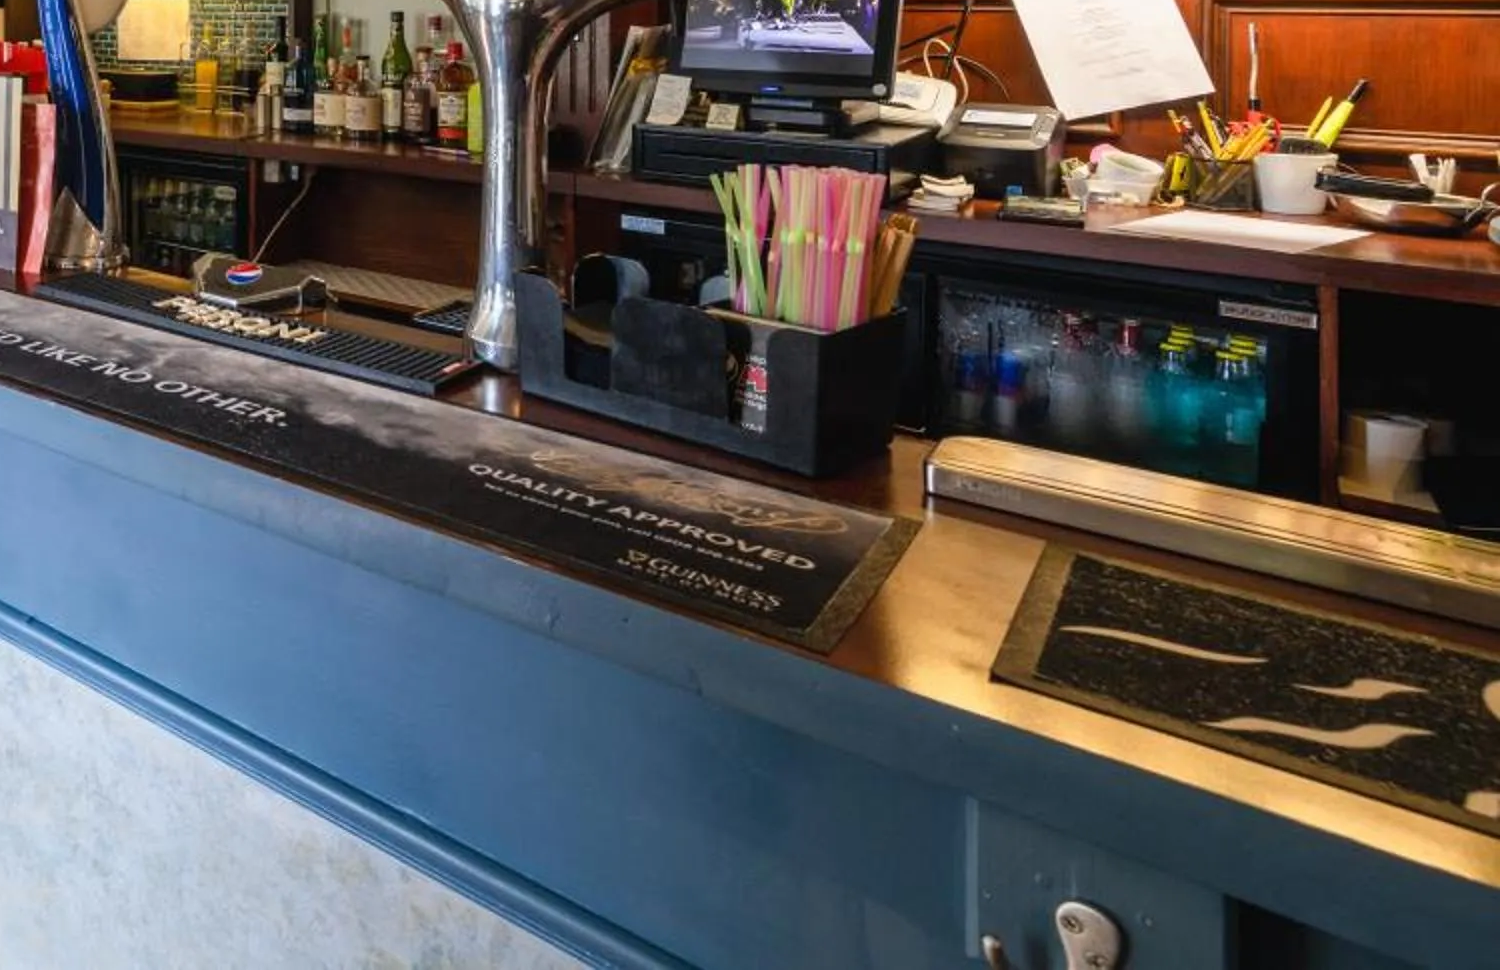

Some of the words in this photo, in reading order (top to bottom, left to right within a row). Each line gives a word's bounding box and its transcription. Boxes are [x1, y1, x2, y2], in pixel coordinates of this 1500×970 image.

[21, 339, 100, 369] LIKE
[92, 362, 153, 384] NO
[154, 380, 289, 428] OTHER.
[468, 462, 609, 508] QUALITY
[607, 503, 817, 571] APPROVED
[648, 557, 784, 608] GUINNESS
